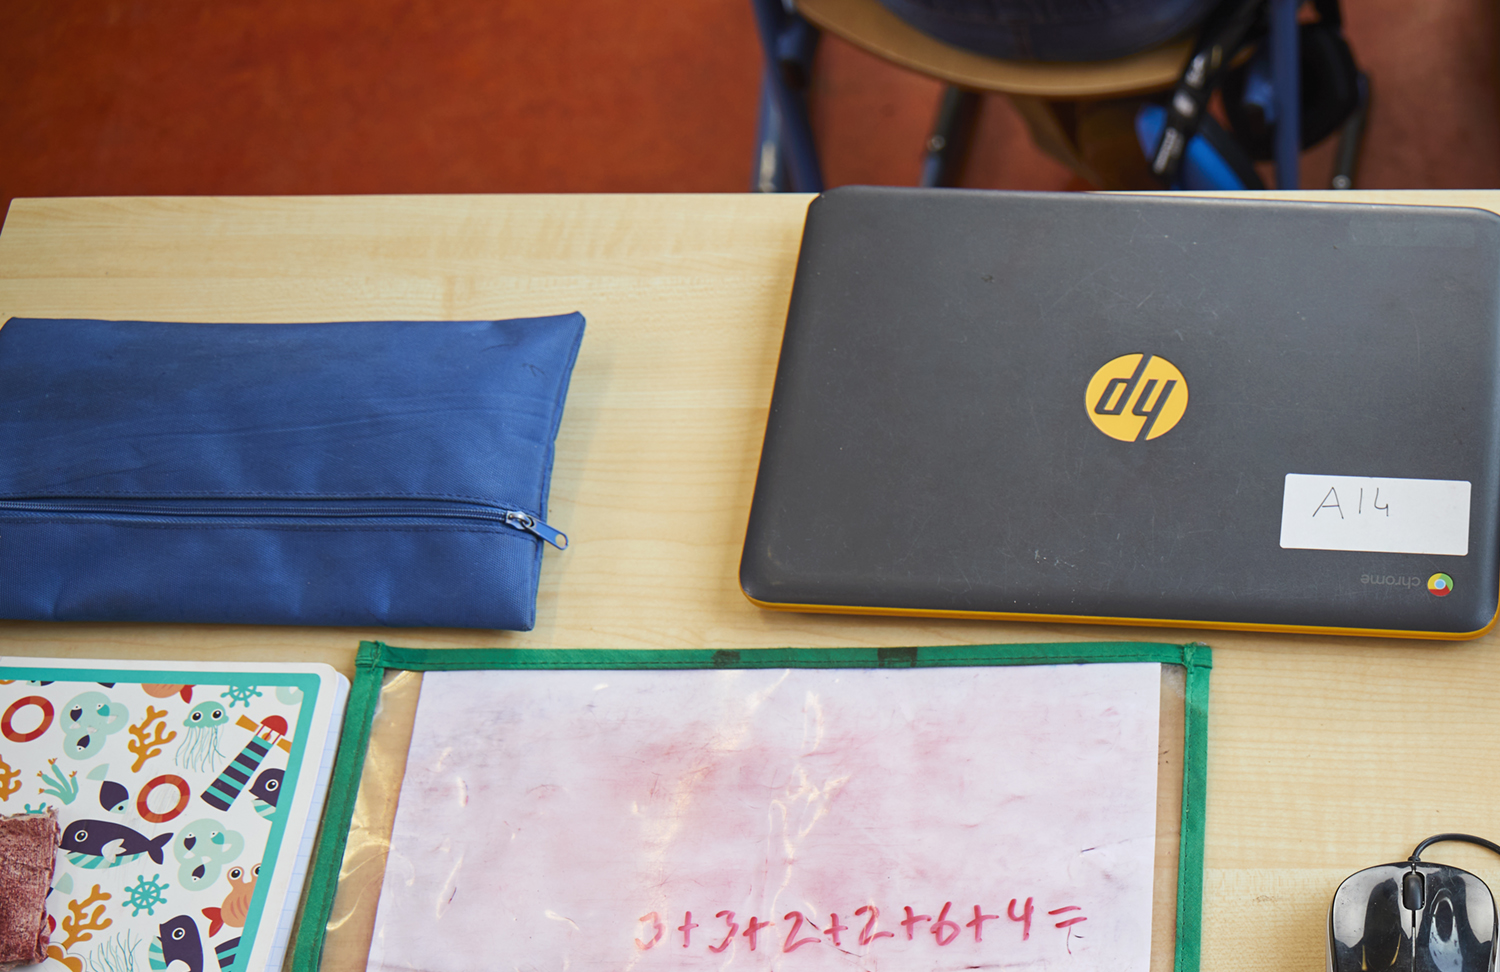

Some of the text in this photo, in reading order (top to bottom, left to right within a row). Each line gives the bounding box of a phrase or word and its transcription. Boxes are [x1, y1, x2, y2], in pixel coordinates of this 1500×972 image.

[1094, 352, 1178, 442] hp
[1313, 486, 1389, 519] A14
[1360, 573, 1421, 589] chrome
